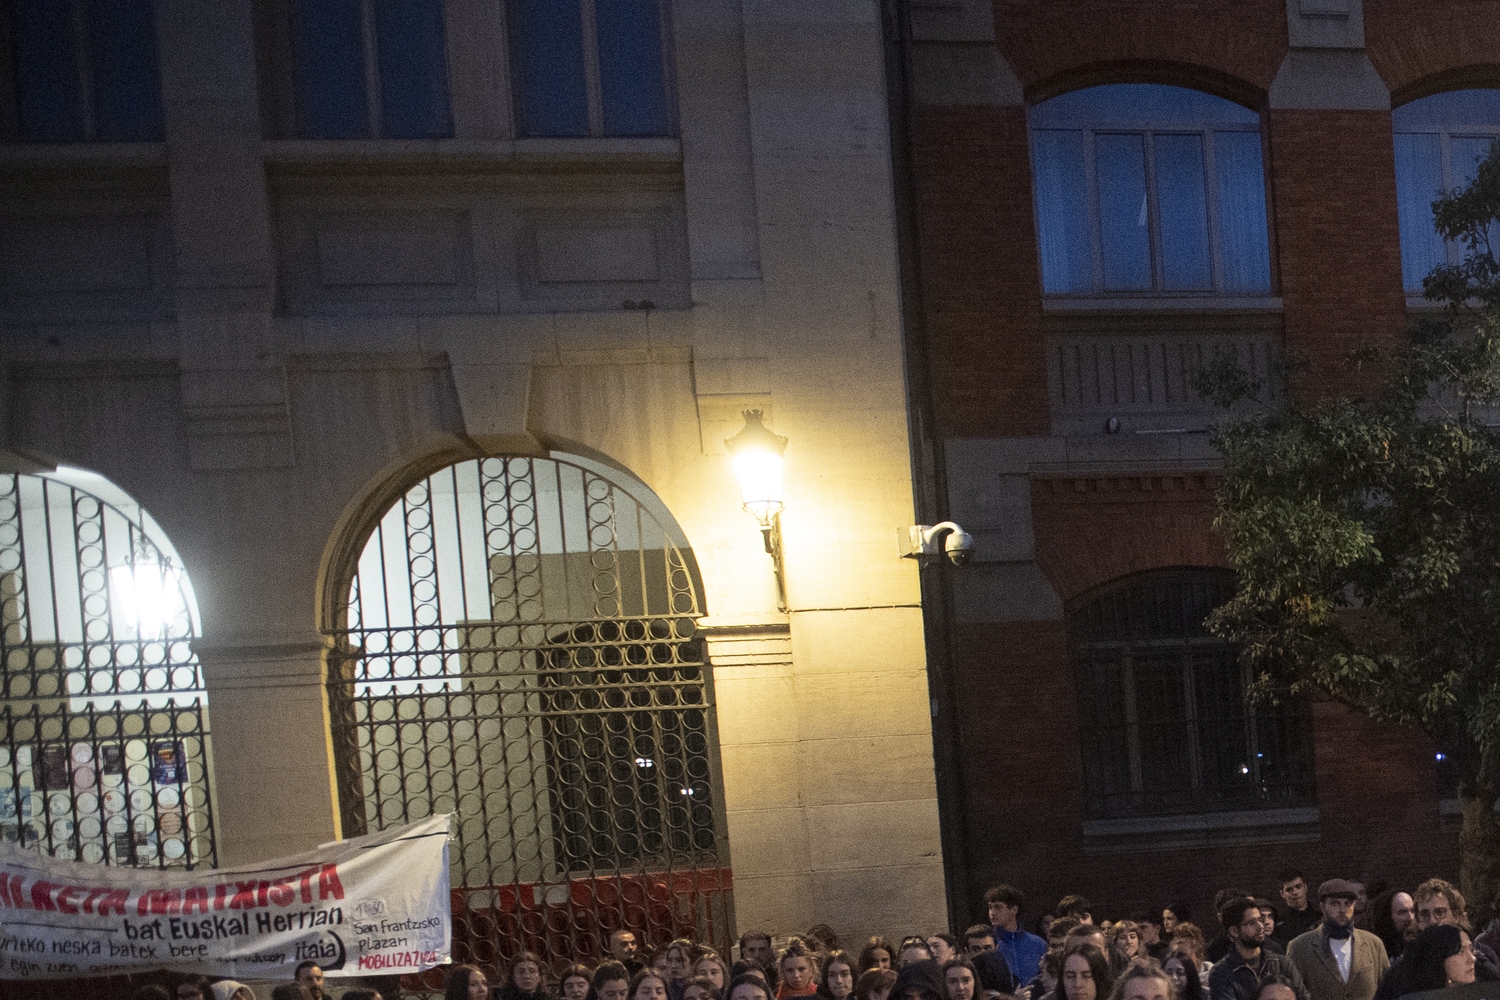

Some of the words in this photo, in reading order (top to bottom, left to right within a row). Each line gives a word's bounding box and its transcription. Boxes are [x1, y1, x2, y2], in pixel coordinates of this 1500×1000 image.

[138, 863, 345, 917] MATXISTA
[124, 915, 166, 941] bat
[169, 911, 249, 941] Euskal
[256, 906, 343, 934] Herrian
[354, 921, 379, 935] San
[381, 917, 440, 934] Frantzisko
[295, 939, 336, 961] itaia
[358, 937, 407, 952] plazan
